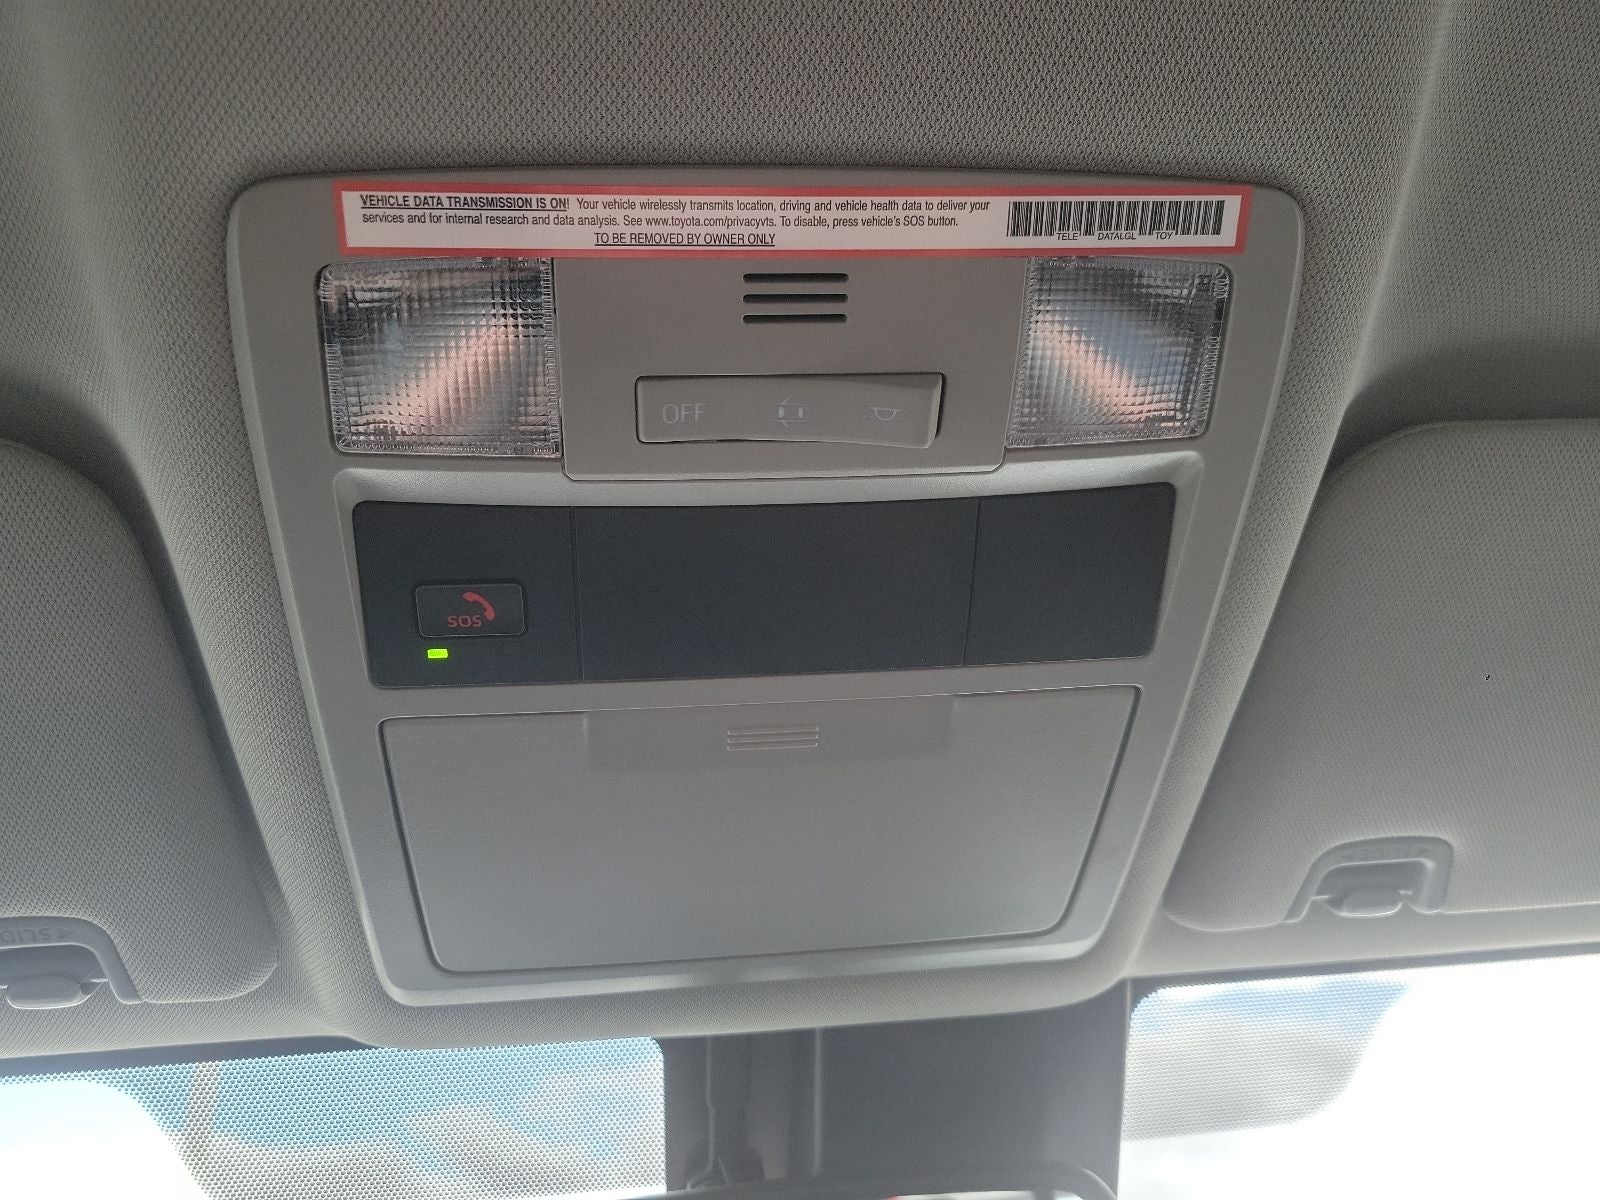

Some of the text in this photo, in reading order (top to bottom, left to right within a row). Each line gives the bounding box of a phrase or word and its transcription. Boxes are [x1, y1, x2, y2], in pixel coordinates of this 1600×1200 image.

[360, 194, 990, 213] VEHICLE DATA TRANSMISSION IS ON! Your vehicle wirelessly transmits location, driving and vehicle health data to deliver your
[362, 212, 404, 223] services
[407, 212, 426, 224] and
[429, 212, 442, 224] for
[445, 212, 483, 225] internal
[485, 213, 529, 225] research
[532, 213, 550, 225] and
[553, 213, 575, 226] data
[577, 215, 620, 228] analysis.
[623, 215, 643, 226] See
[645, 215, 777, 229] www.toyota.com/privacyvts.
[780, 216, 791, 227] To
[793, 216, 830, 228] disable,
[832, 218, 859, 229] press
[903, 216, 925, 227] SOS
[927, 216, 958, 227] button.
[594, 233, 776, 245] TO BE REMOVED BY OWNER ONLY
[1056, 232, 1173, 241] TELE DATALGL TOY
[662, 403, 706, 424] OFF
[447, 614, 482, 628] SOS
